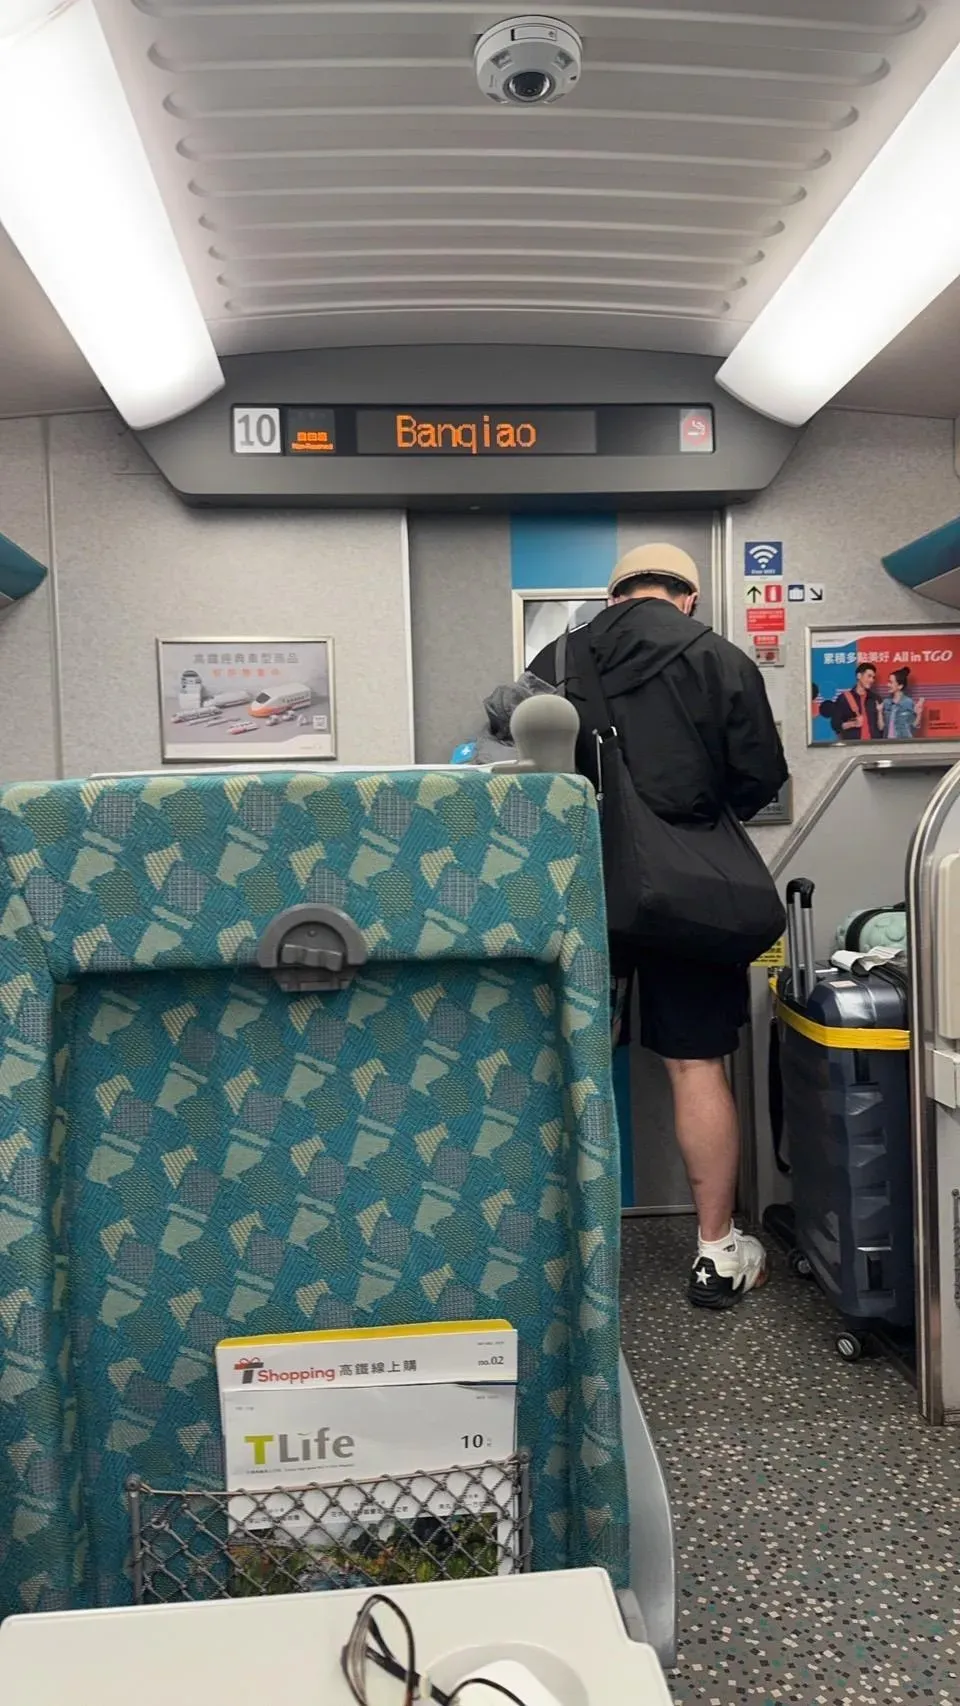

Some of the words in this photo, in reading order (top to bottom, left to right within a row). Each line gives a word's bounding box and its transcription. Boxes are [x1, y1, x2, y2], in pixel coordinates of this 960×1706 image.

[237, 414, 276, 447] 10
[396, 415, 536, 454] Banqiao
[893, 651, 909, 662] All
[911, 651, 922, 662] in
[922, 649, 954, 662] TGO
[339, 1360, 417, 1376] 高鐵線上購
[478, 1356, 504, 1366] no.02
[461, 1434, 484, 1449] 10
